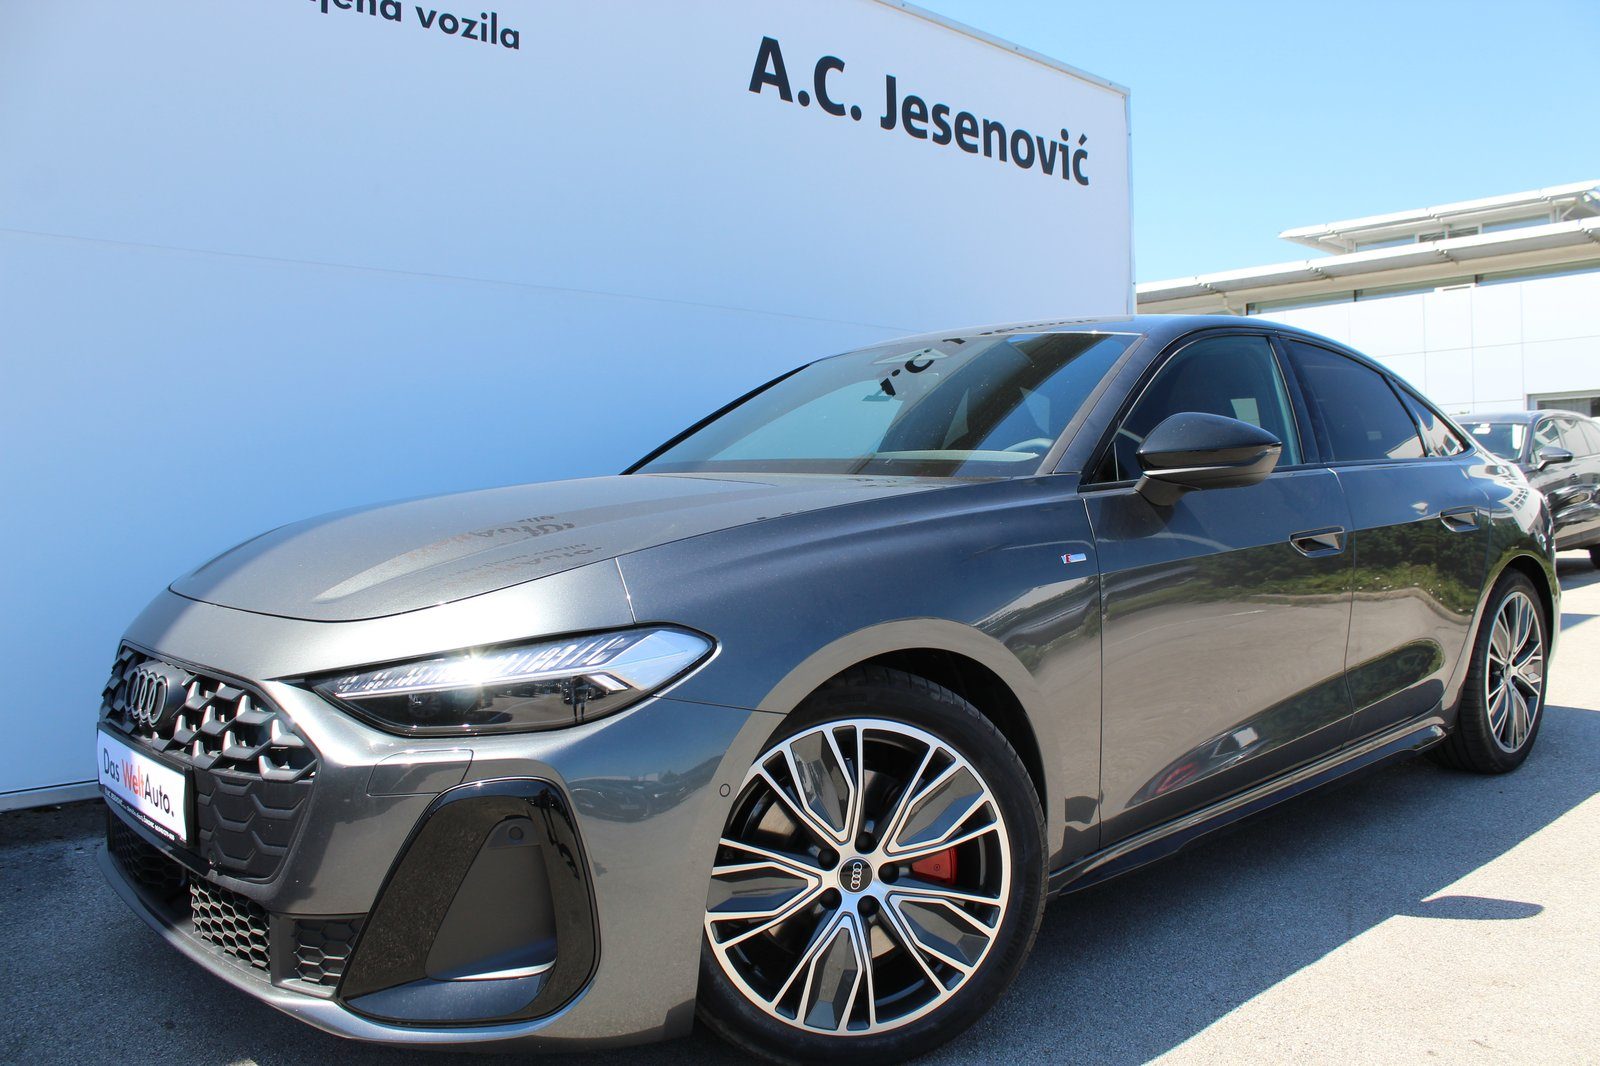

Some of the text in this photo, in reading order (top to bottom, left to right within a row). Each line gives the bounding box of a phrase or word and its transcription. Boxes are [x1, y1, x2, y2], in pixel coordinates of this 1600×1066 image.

[415, 6, 519, 50] vozila
[749, 35, 1089, 186] A.C. Jesenović
[103, 747, 120, 782] Das
[121, 758, 174, 817] WeltAuto.
